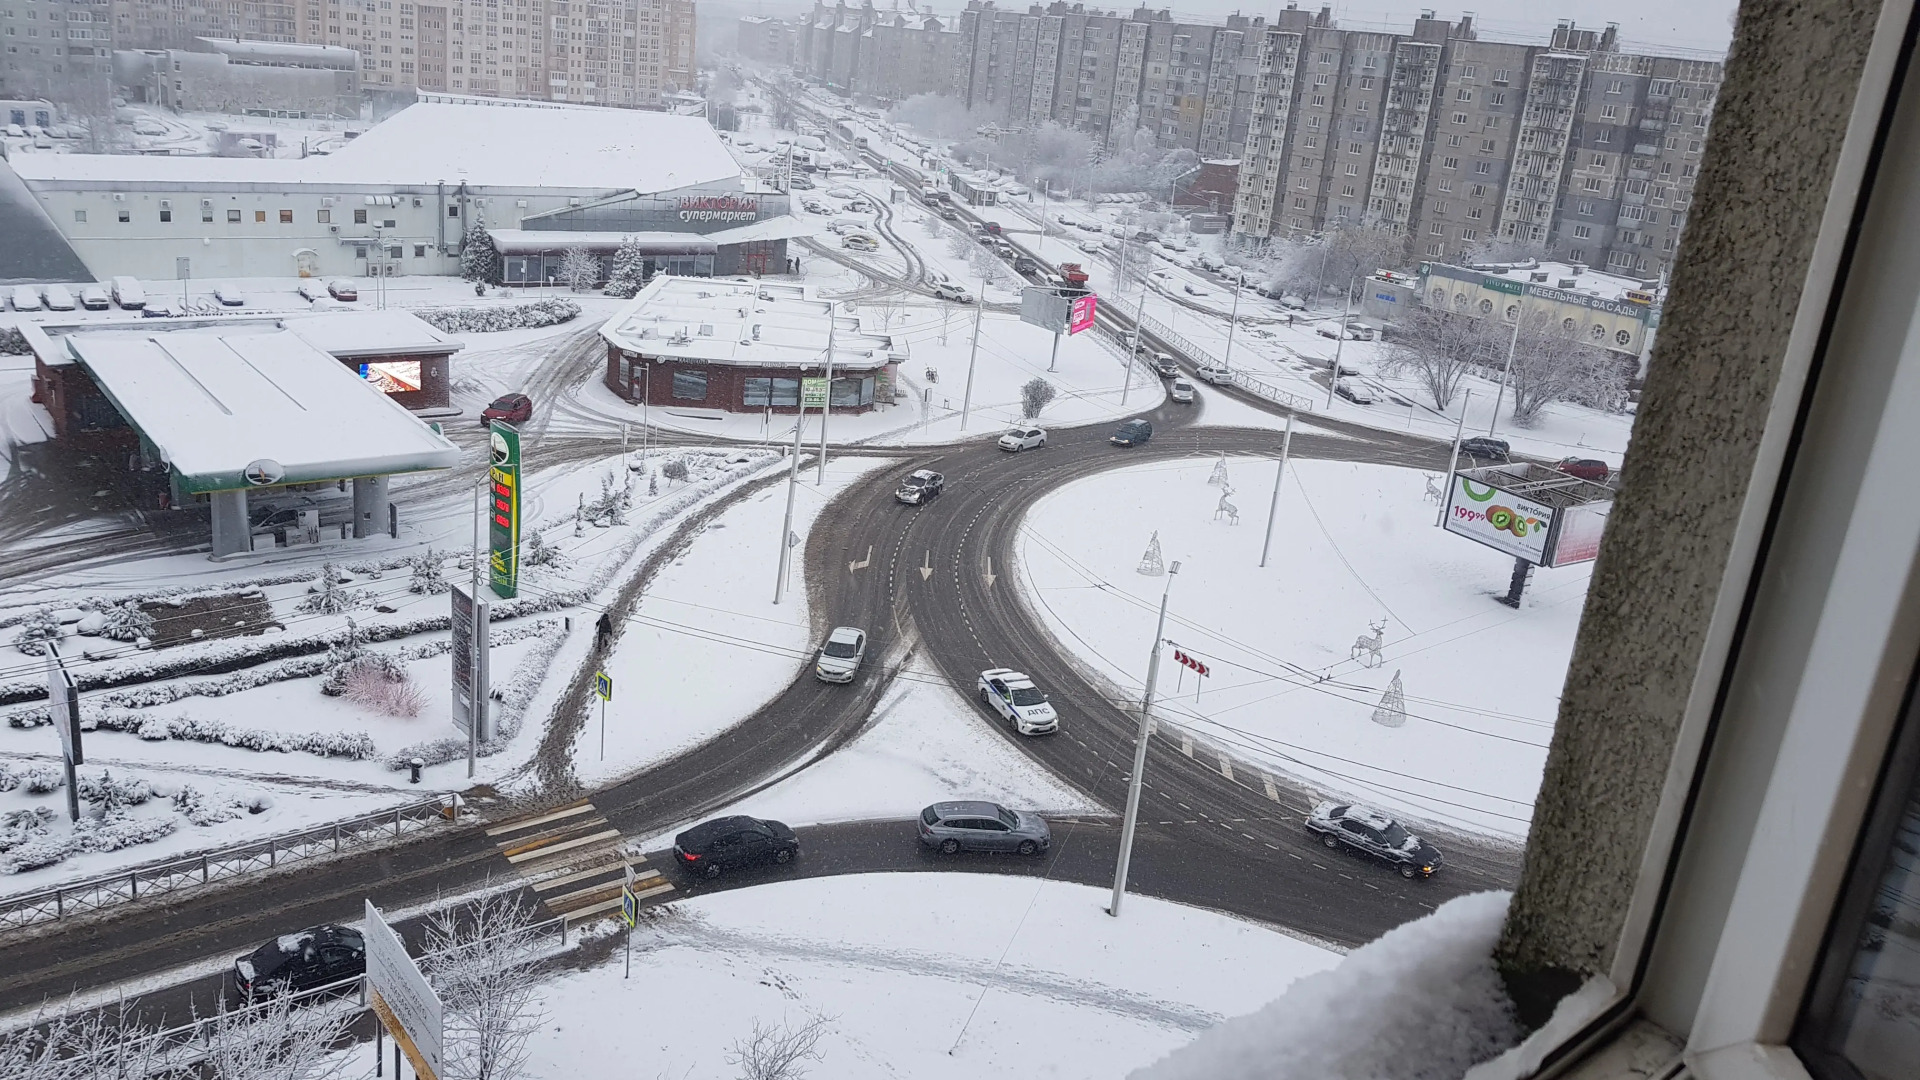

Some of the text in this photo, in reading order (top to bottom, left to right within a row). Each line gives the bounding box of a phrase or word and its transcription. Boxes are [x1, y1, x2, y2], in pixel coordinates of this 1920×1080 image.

[679, 193, 757, 210] ВИКТОРИЯ
[679, 209, 756, 223] супермаркет
[1528, 286, 1639, 317] МЕБЕЛЬНЫЕ ФАСАДЫ
[1027, 707, 1050, 717] ДПС
